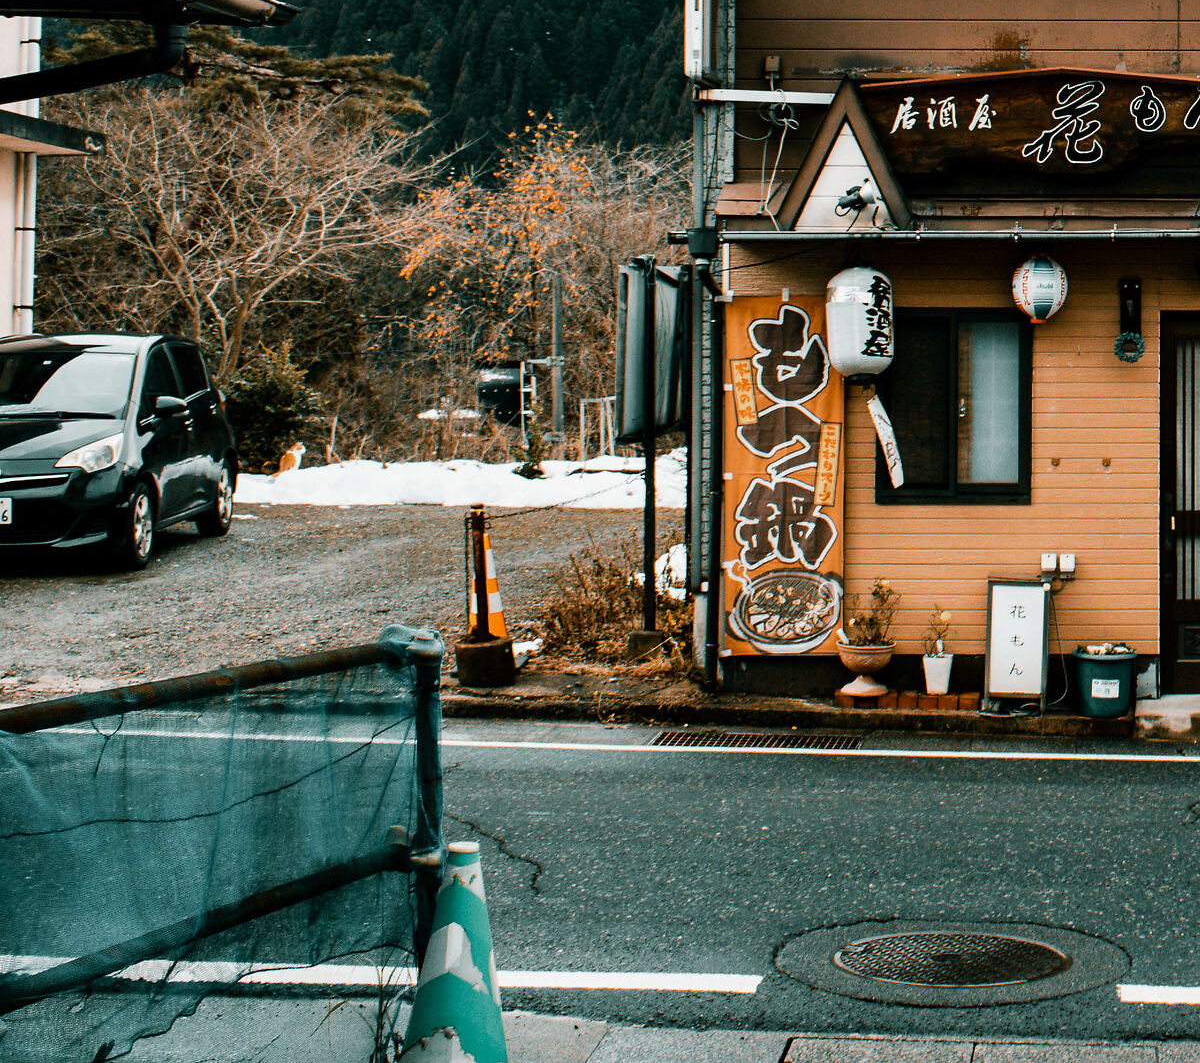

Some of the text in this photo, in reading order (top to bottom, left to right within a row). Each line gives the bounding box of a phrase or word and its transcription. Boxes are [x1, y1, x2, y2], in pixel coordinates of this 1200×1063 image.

[890, 94, 997, 134] 居酒屋
[734, 304, 839, 570] もつ鍋
[818, 425, 837, 502] こだわりスープ
[1009, 605, 1027, 676] 花もん
